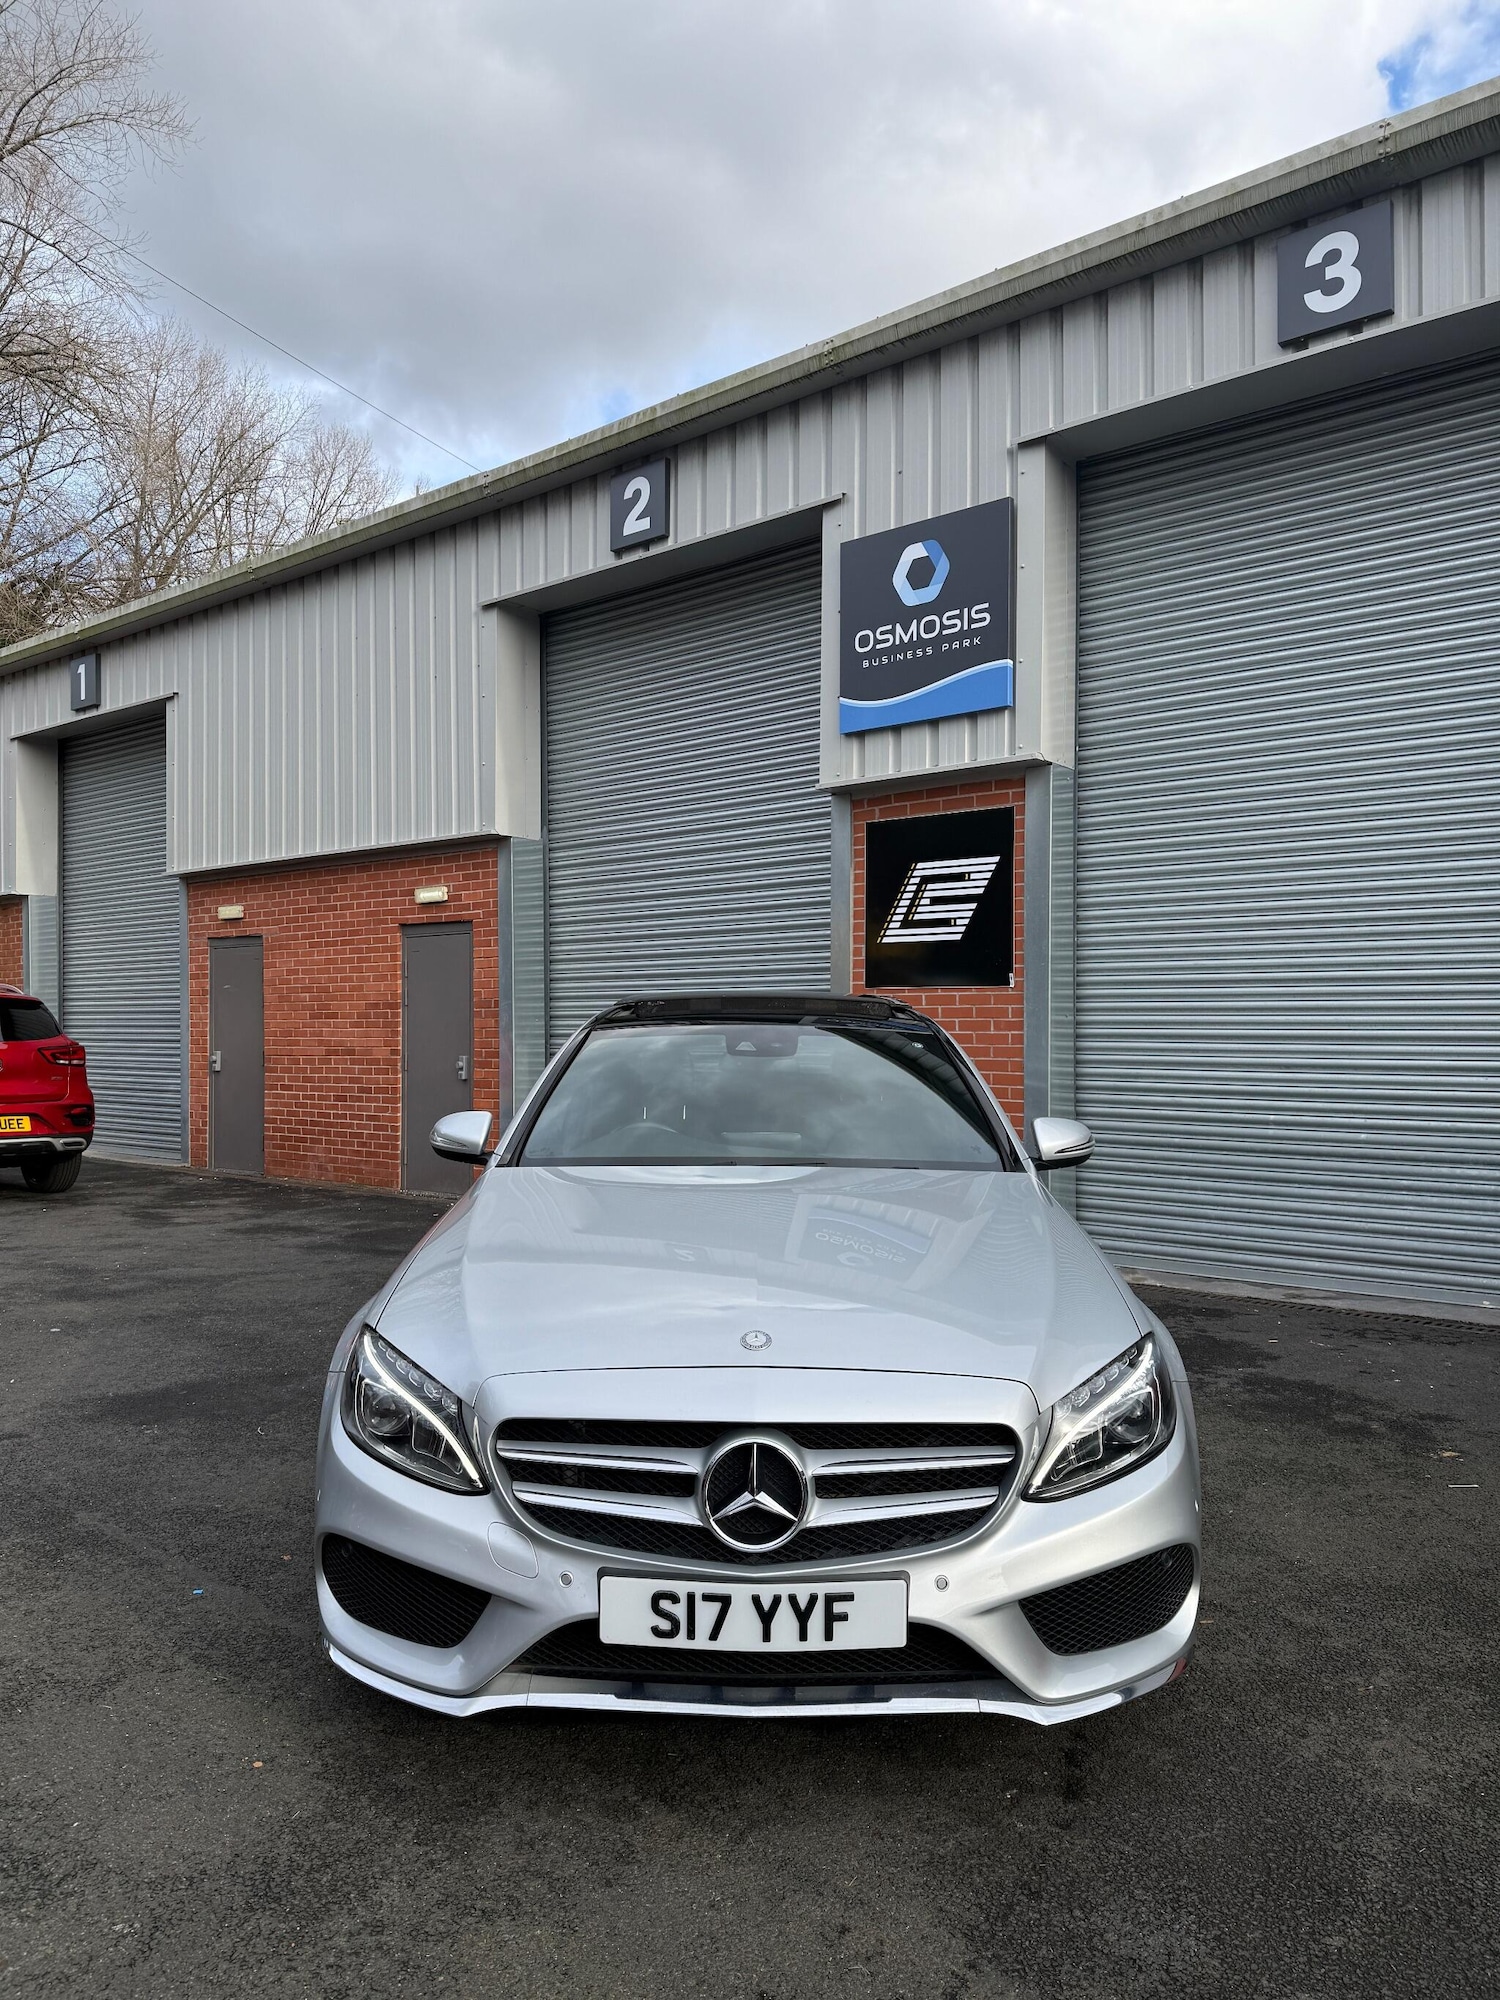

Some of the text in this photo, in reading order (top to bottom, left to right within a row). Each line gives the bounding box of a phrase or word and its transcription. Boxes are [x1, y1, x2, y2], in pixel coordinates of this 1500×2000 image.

[1303, 230, 1362, 313] 3
[622, 476, 651, 537] 2
[854, 602, 992, 653] OSMOSIS
[862, 636, 982, 668] BUSINESS PARK
[77, 663, 86, 701] 1
[650, 1589, 855, 1643] S17 YYF
